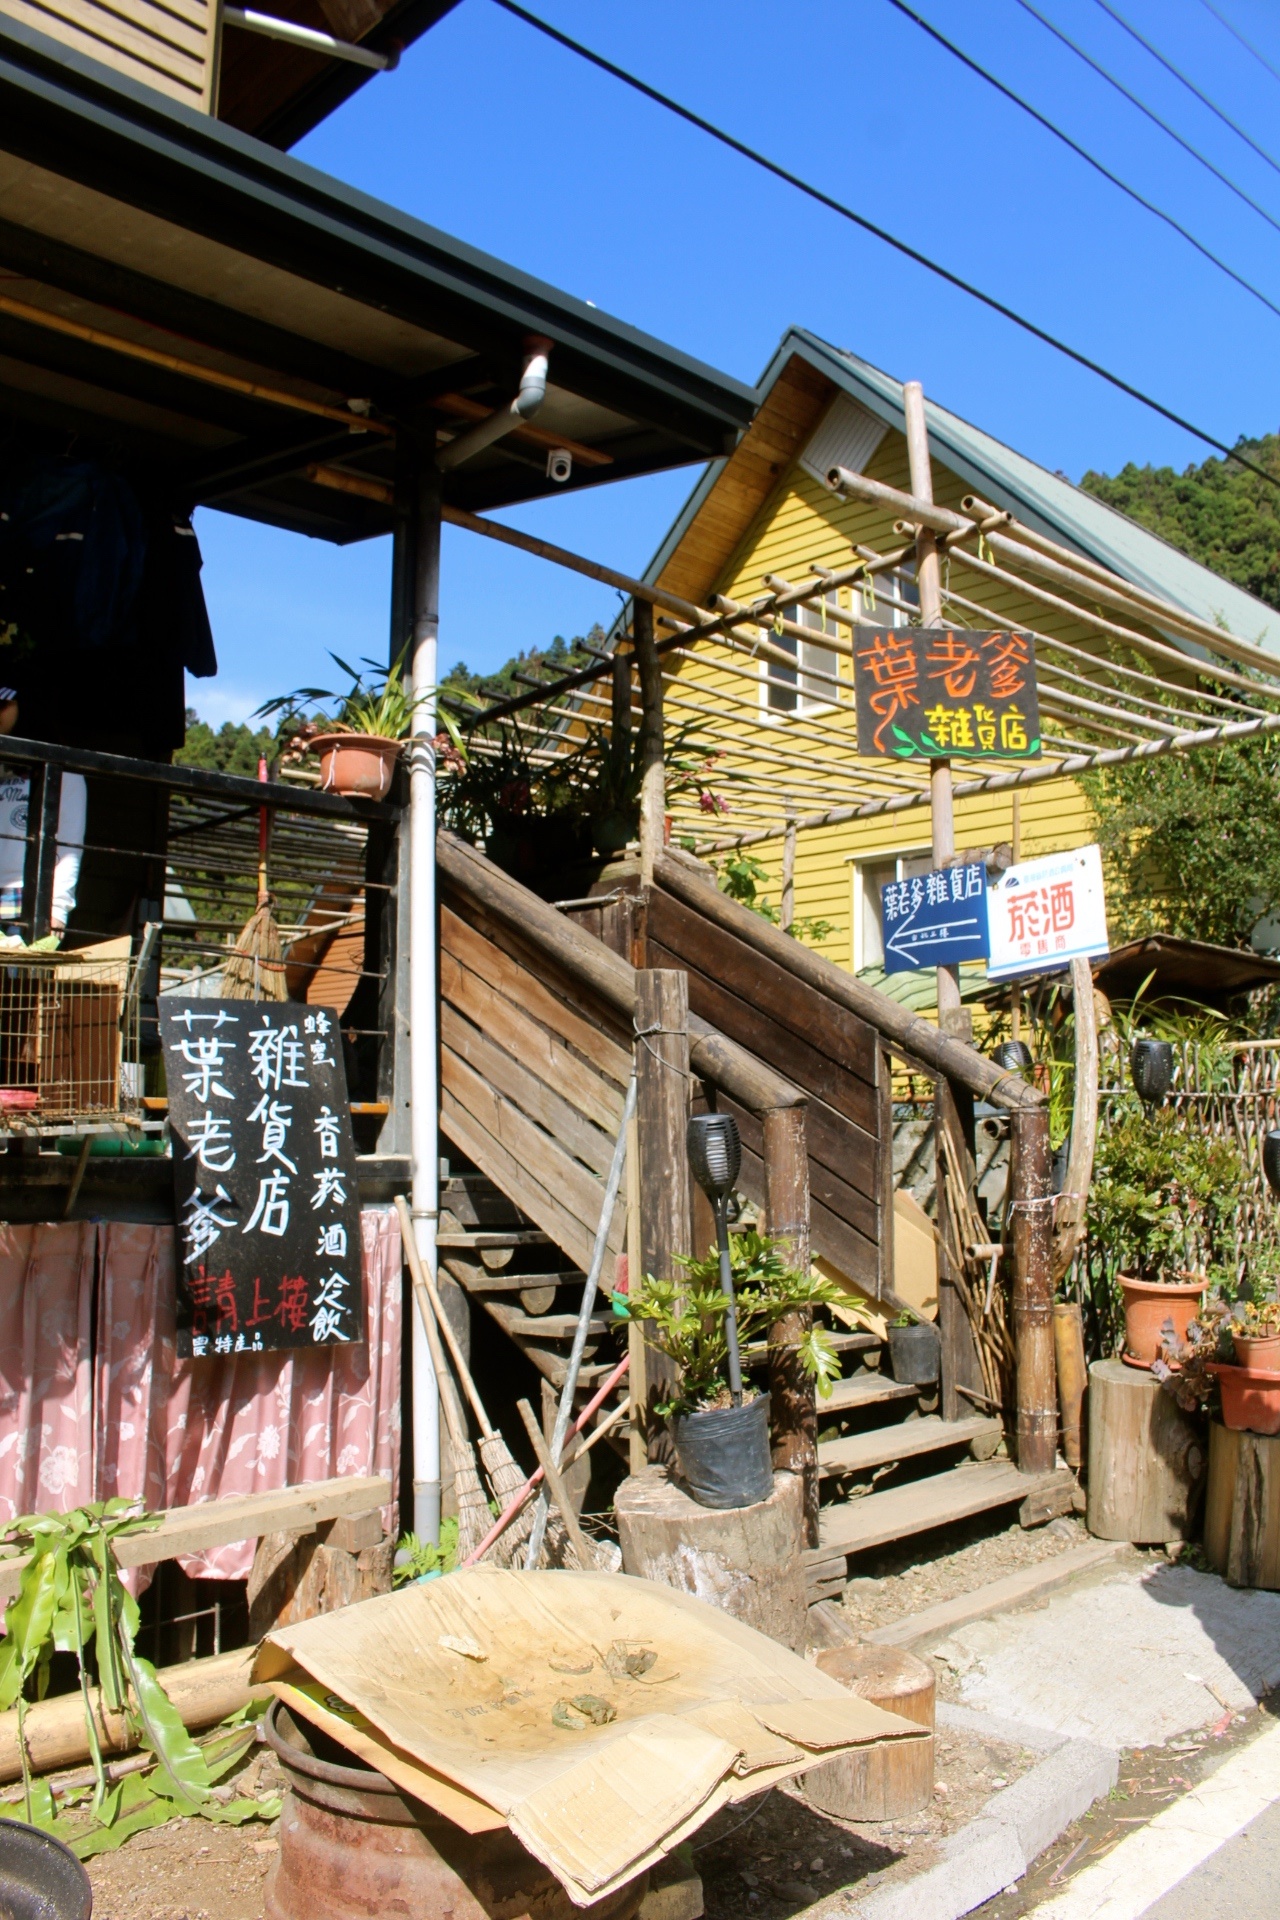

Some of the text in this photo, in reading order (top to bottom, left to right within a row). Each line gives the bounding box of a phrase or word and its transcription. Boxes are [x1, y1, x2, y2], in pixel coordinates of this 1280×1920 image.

[857, 631, 1030, 753] 葉老爹
[924, 703, 1028, 751] 雜貨店
[884, 863, 983, 922] 葉老爹雜貨店
[1006, 880, 1075, 943] 菸酒
[170, 1009, 240, 1266] 葉老爹
[242, 1014, 310, 1237] 雜貨店
[188, 1263, 309, 1337] 請上樓
